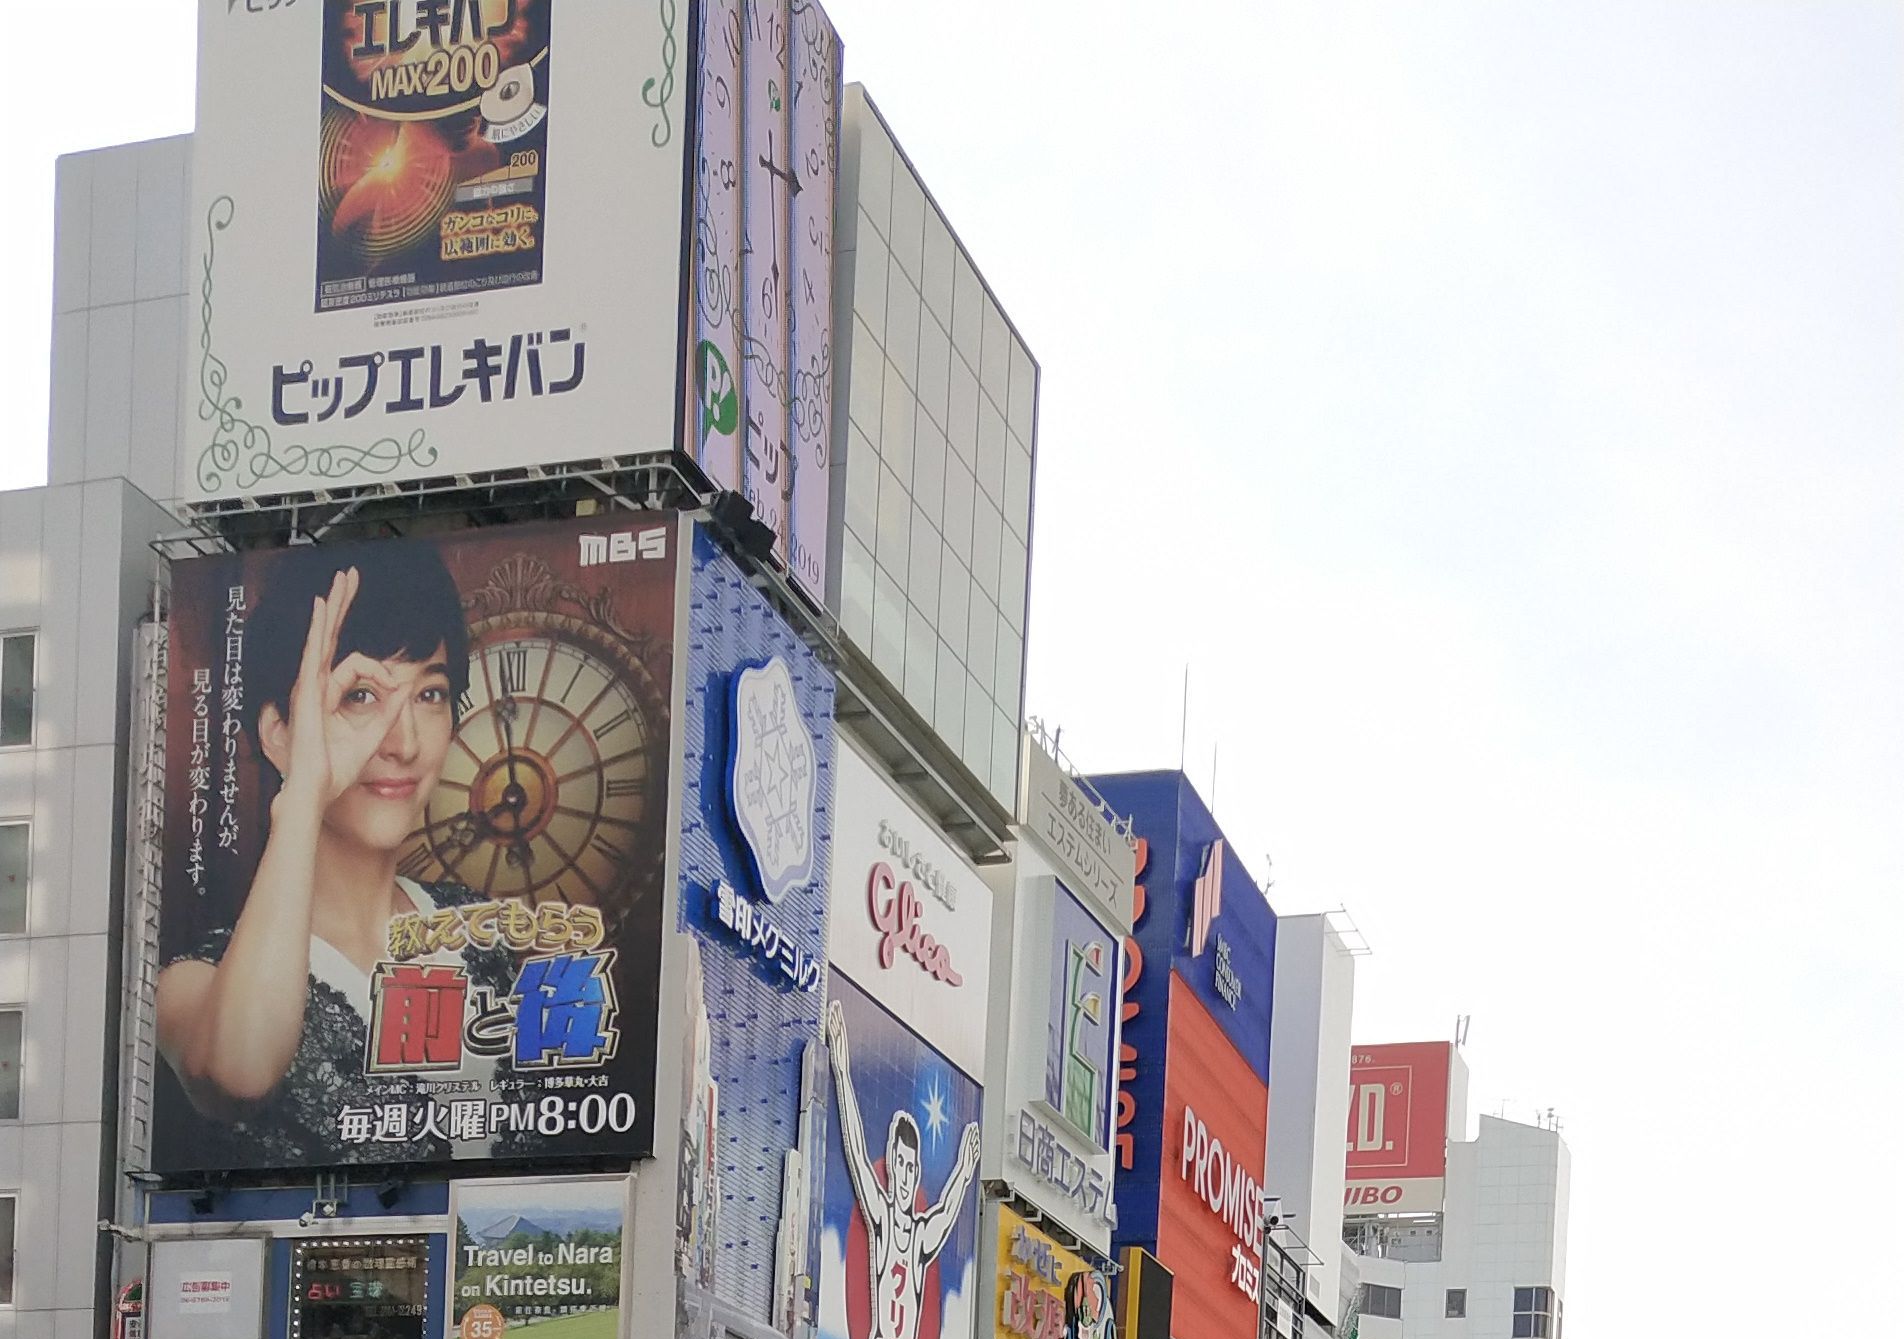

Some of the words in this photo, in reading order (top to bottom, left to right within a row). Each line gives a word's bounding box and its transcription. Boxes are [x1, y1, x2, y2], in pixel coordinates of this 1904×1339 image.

[511, 152, 536, 167] 200
[271, 327, 586, 425] ピップエレキバン
[578, 527, 667, 567] MBS
[218, 585, 246, 855] 見た目は変わりませんが、
[185, 668, 212, 896] 見る目が変わります。
[1047, 812, 1118, 908] エステムシリーズ
[387, 901, 603, 957] 教えてもらう
[718, 880, 820, 993] 雪印メグミルク
[867, 861, 963, 987] Glico
[365, 950, 621, 1076] 前と後
[1181, 1105, 1265, 1259] PROMISE
[461, 1284, 480, 1296] on
[484, 1273, 592, 1297] Kintetsu.
[464, 1243, 534, 1267] Travel
[538, 1250, 554, 1265] to
[557, 1242, 613, 1265] Nara
[470, 1321, 493, 1338] 35
